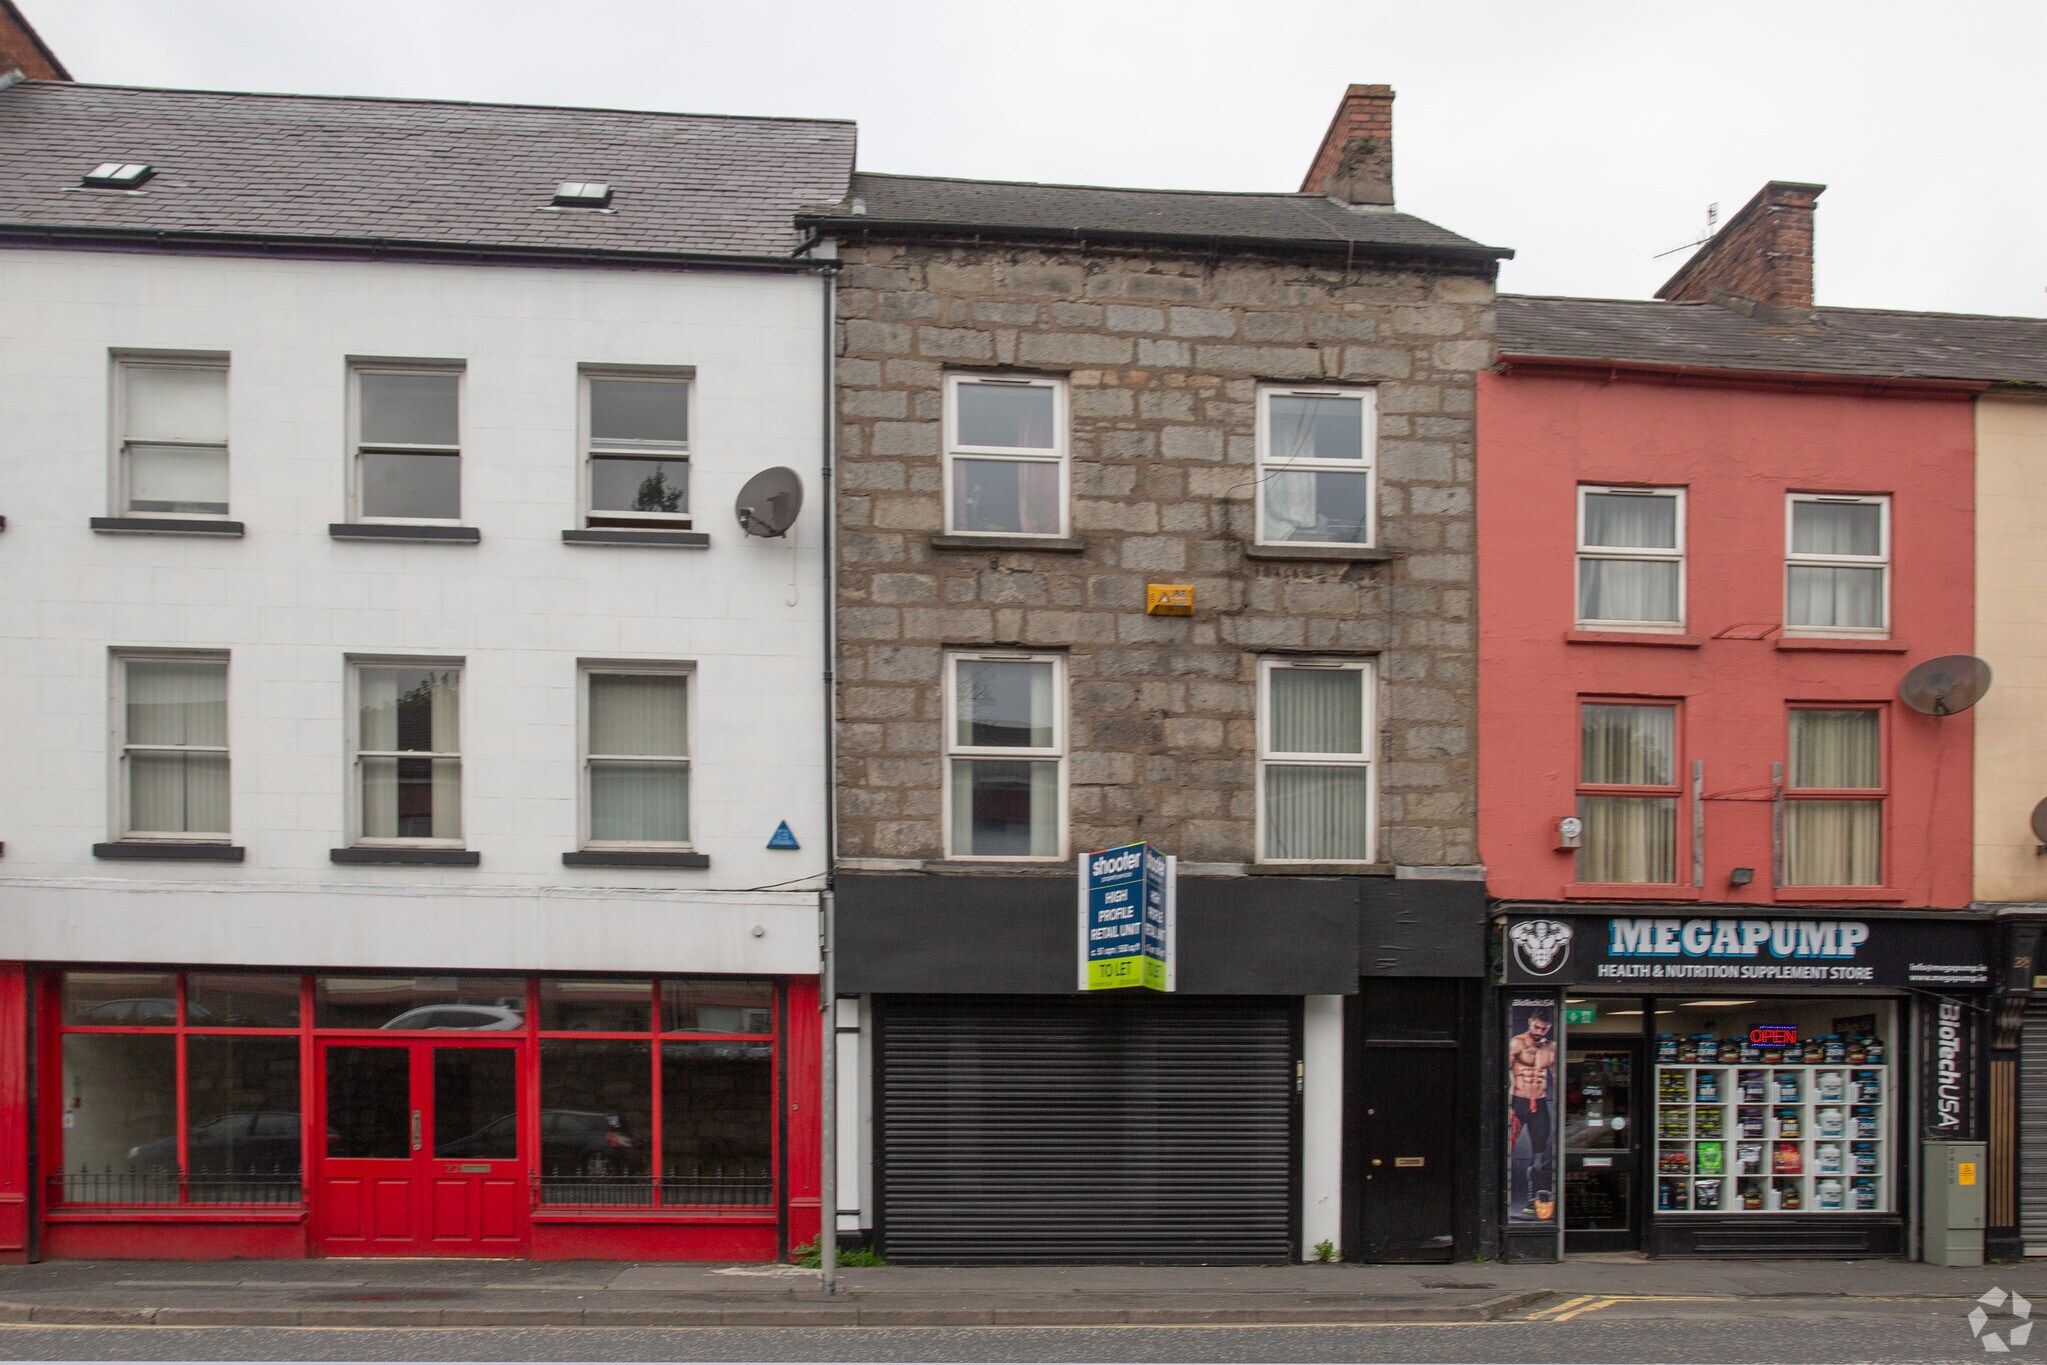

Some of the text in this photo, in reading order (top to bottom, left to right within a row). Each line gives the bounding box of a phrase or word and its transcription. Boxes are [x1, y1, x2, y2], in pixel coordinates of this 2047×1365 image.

[1092, 851, 1141, 877] shooter
[1105, 888, 1128, 904] HIGH
[1098, 905, 1134, 923] PROFILE
[1090, 926, 1119, 940] RETAIL
[1119, 922, 1141, 937] UNIT
[1608, 919, 1870, 958] MEGAPUMP
[1099, 963, 1113, 978] TO
[1115, 961, 1132, 977] LET
[1598, 964, 1874, 980] HEALTH & NUTRITION SUPPLEMENT STORE
[1750, 1029, 1797, 1043] OPEN
